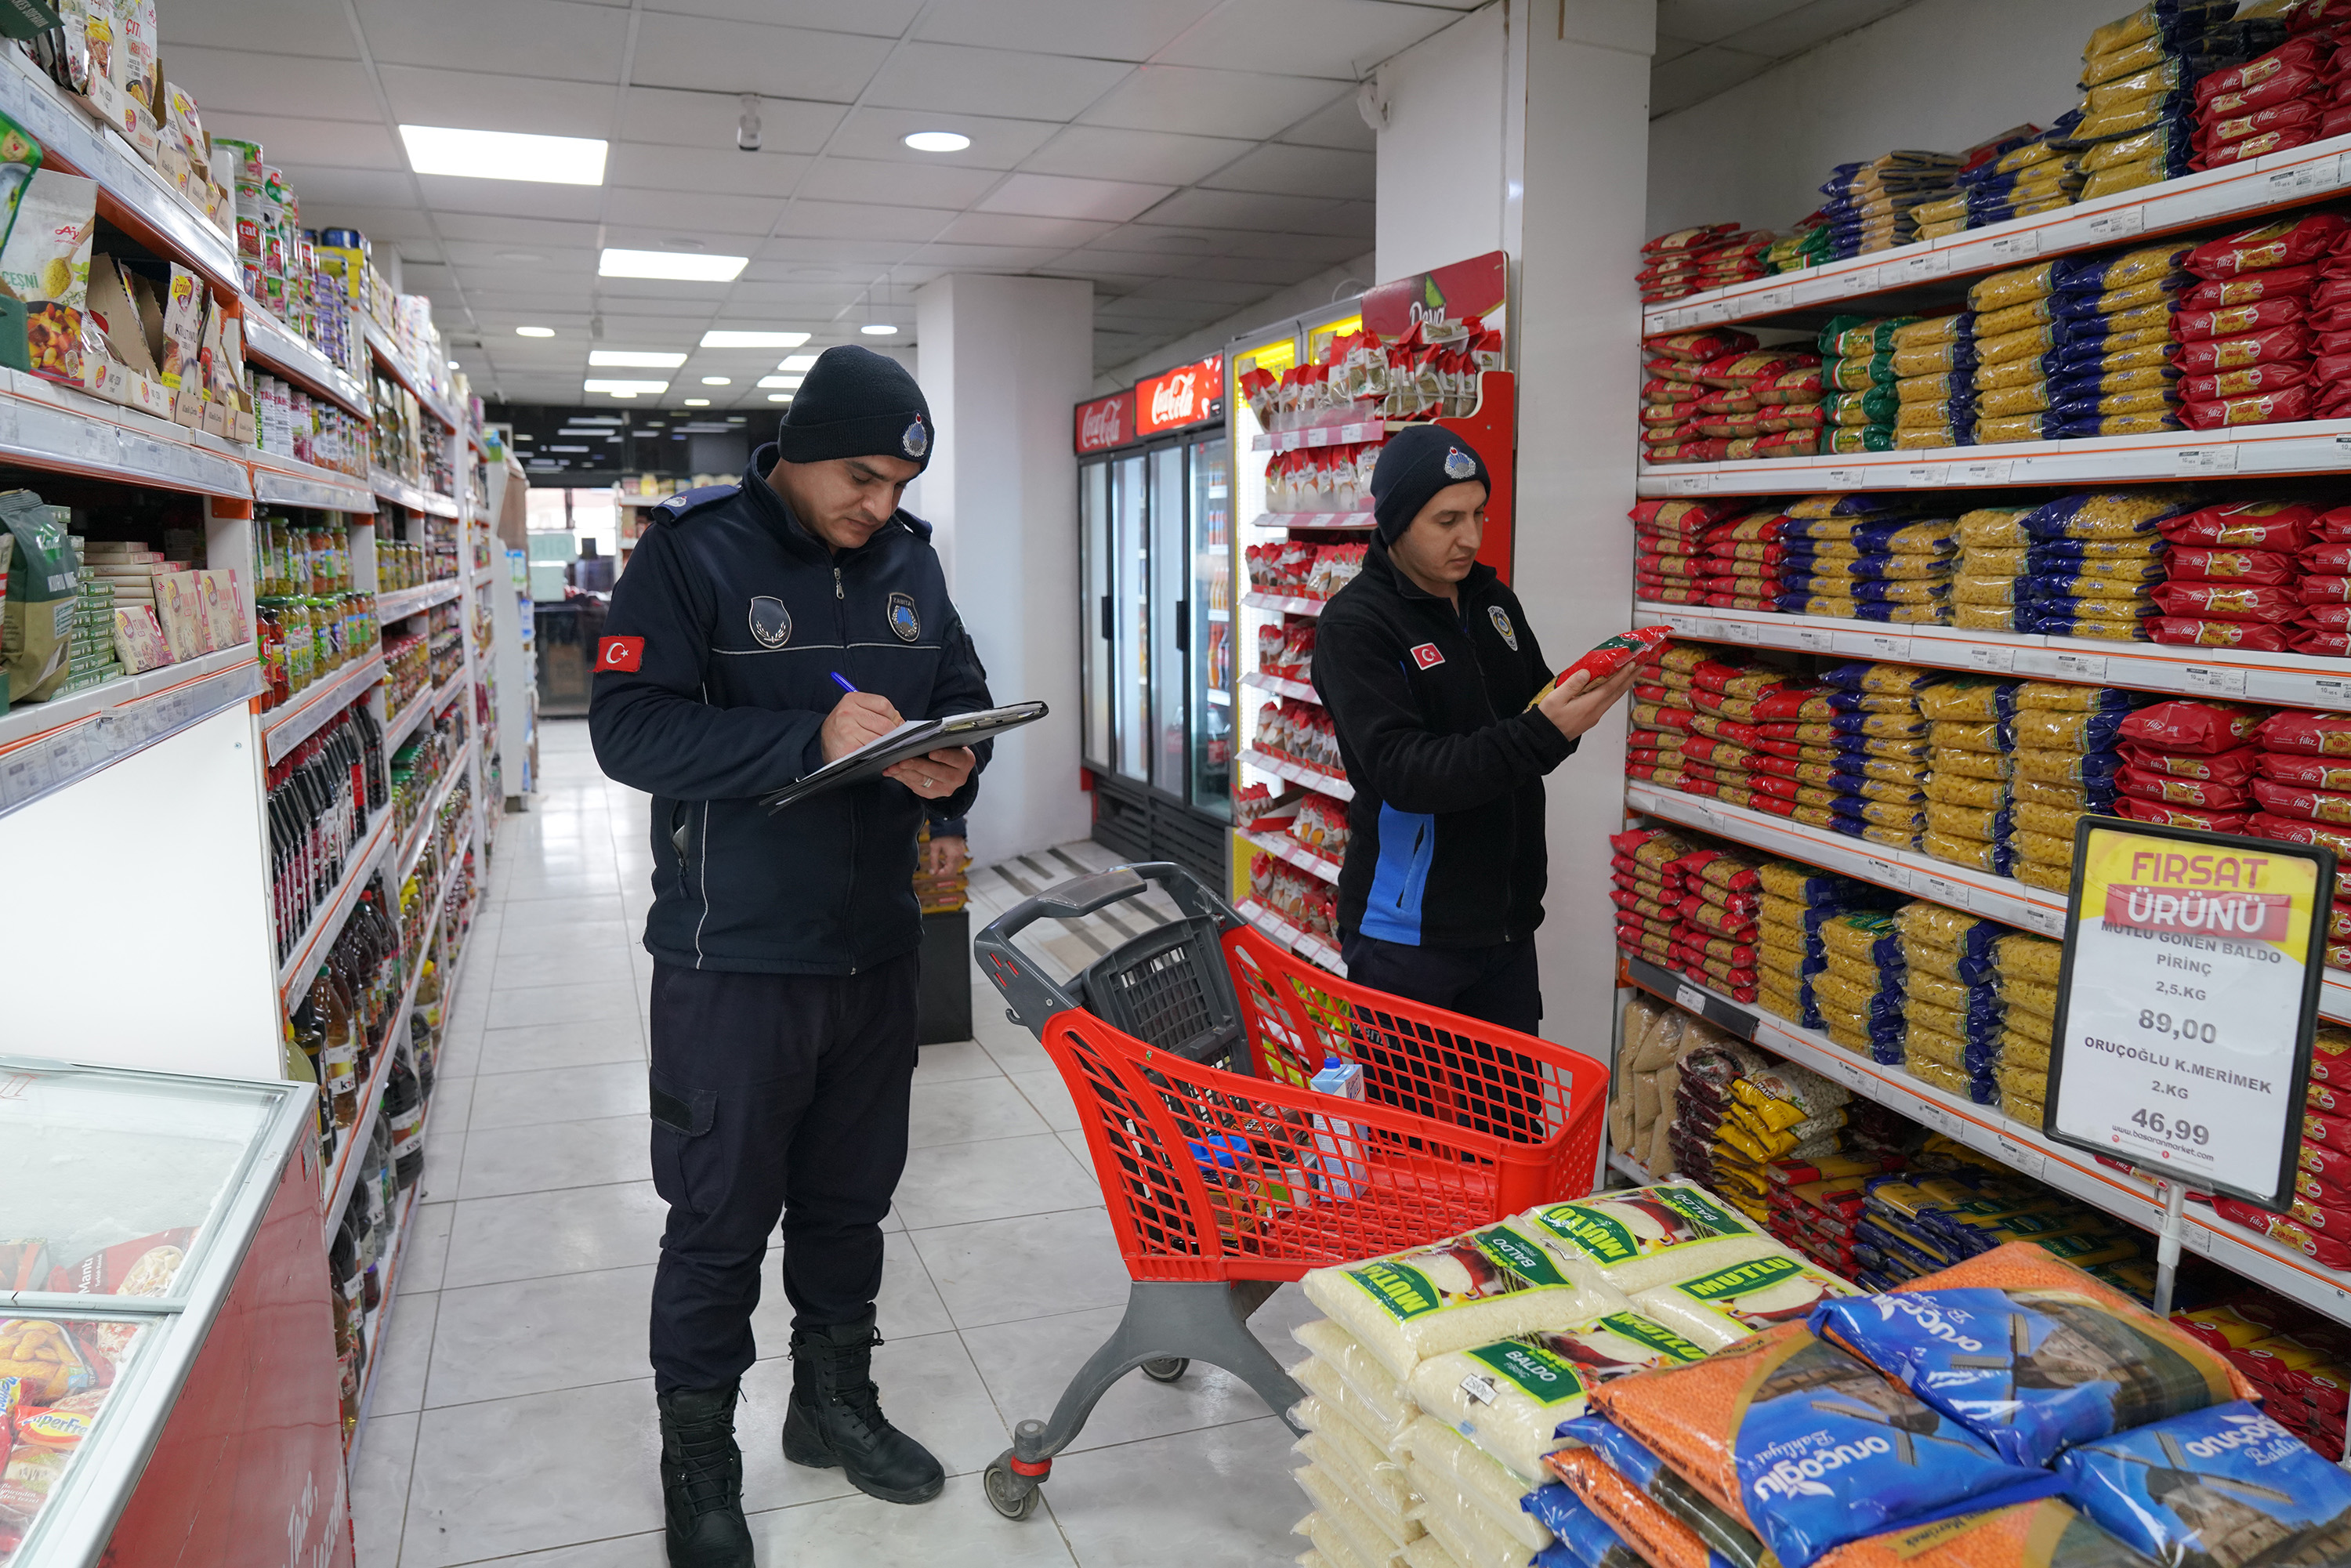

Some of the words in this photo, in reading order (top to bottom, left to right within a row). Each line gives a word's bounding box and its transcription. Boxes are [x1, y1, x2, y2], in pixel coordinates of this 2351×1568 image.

[2220, 77, 2241, 89] filiz
[2244, 83, 2266, 96] filiz
[2257, 111, 2277, 122] filiz
[2219, 147, 2240, 158] filiz
[238, 223, 259, 237] tat
[2216, 258, 2234, 269] filiz
[2, 271, 39, 289] ÇEŞNİ
[2204, 290, 2219, 299] filiz
[2194, 319, 2210, 330] filiz
[2198, 353, 2214, 362] filiz
[2198, 382, 2214, 393] filiz
[2207, 408, 2223, 419] filiz
[2201, 526, 2217, 537] filiz
[2190, 556, 2206, 567] filiz
[2331, 556, 2348, 567] filiz
[2327, 585, 2344, 596] filiz
[893, 596, 912, 607] ZABITA
[2189, 592, 2208, 603] filiz
[2329, 614, 2347, 625] filiz
[2180, 625, 2197, 636] filiz
[2328, 638, 2346, 649] filiz
[2146, 719, 2164, 731] filiz
[2298, 736, 2318, 747] filiz
[2150, 759, 2166, 771] filiz
[2301, 771, 2320, 782] filiz
[2146, 784, 2161, 794] filiz
[2293, 798, 2313, 809] filiz
[2289, 832, 2308, 844] filiz
[2130, 851, 2269, 889] FIRSAT
[2127, 886, 2266, 932] ÜRÜNÜ
[2101, 920, 2154, 940] MUTLU
[2222, 943, 2281, 964] BALDO
[2157, 953, 2212, 977] PİRİNÇ
[2155, 981, 2207, 1001] 2,5.KG
[2138, 1009, 2216, 1044] 89,00
[2085, 1036, 2169, 1067] ORUÇOĞLU
[2175, 1059, 2272, 1095] K.MERİMEK
[1755, 1081, 1777, 1101] MANTI
[2151, 1080, 2189, 1099] 2.KG
[2131, 1108, 2209, 1146] 46,99
[2111, 1124, 2215, 1162] www.basaranmarket.com
[1672, 1193, 1719, 1221] BALDO
[2248, 1215, 2266, 1230] filiz
[1550, 1207, 1630, 1258] MUTLU
[2277, 1229, 2299, 1246] KELEBEK
[1492, 1238, 1537, 1268] BALDO
[78, 1256, 94, 1294] Mantı
[1690, 1257, 1795, 1297] MUTLU
[1610, 1313, 1709, 1360] MUTLU
[1505, 1349, 1558, 1382] BALDO
[31, 1412, 88, 1436] uperFre
[2243, 1437, 2312, 1467] Bakliy
